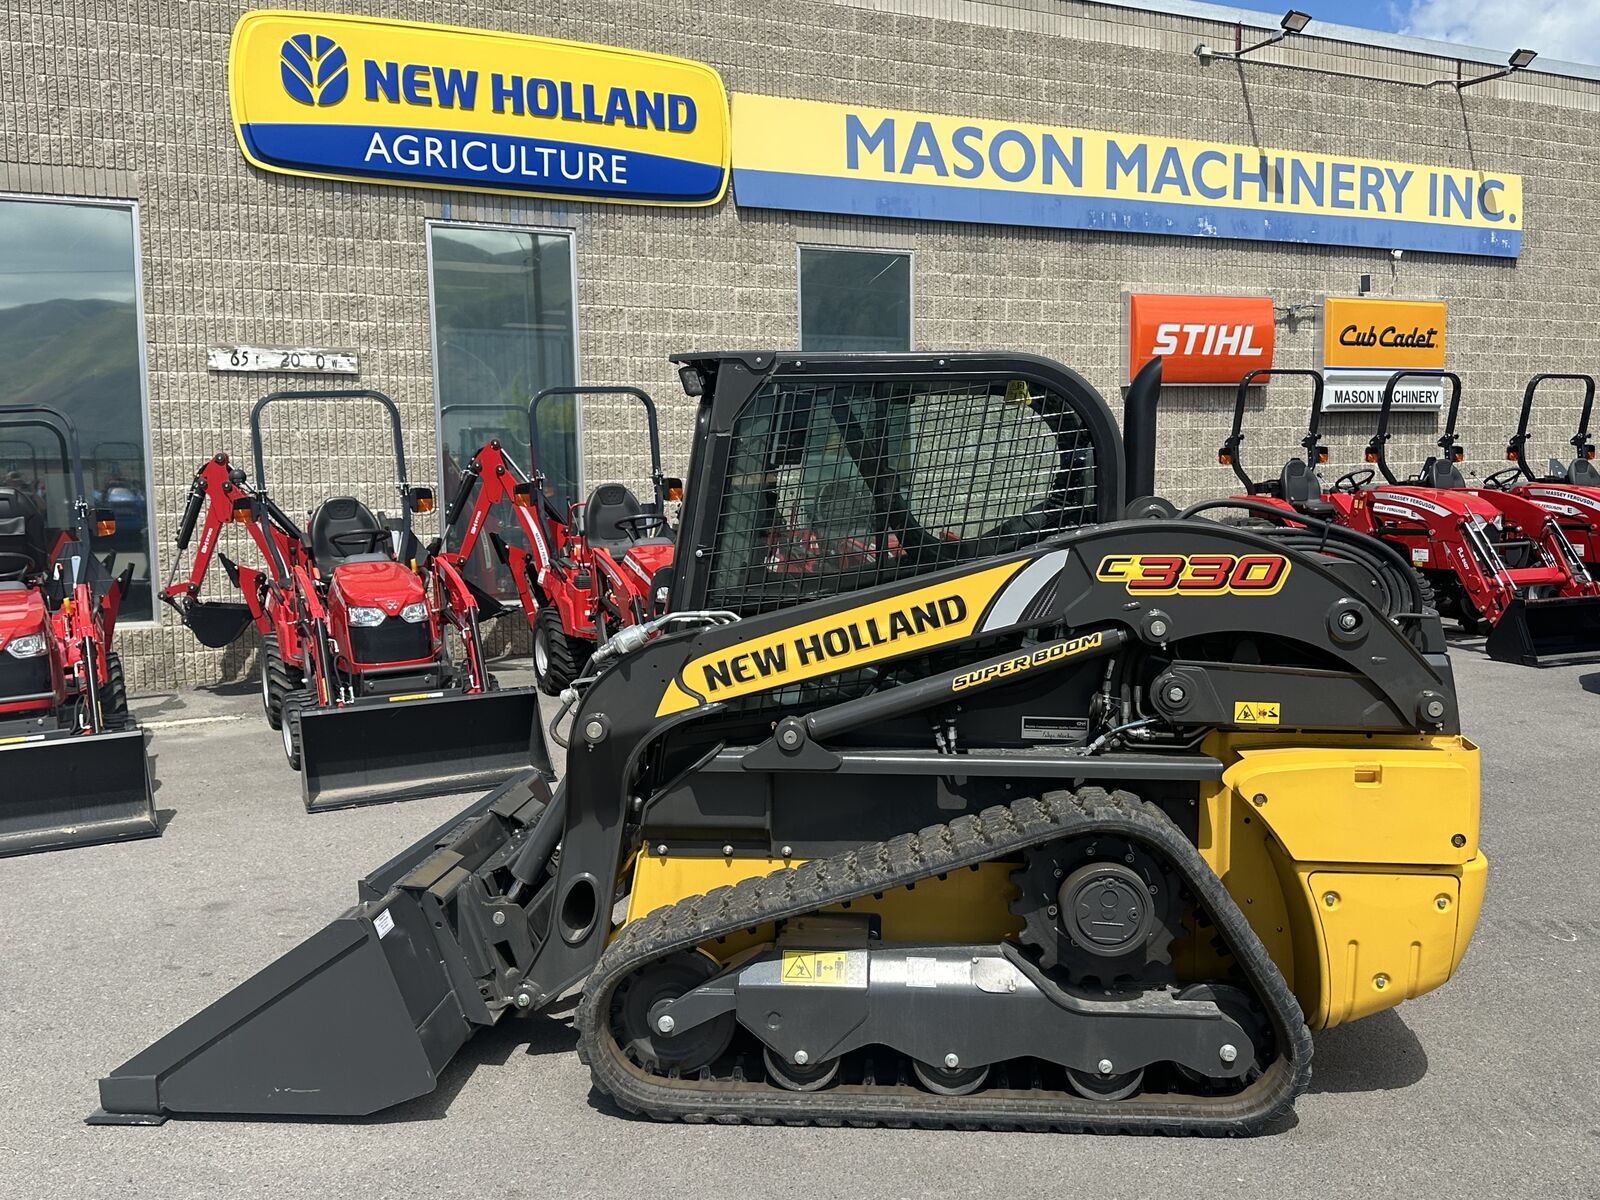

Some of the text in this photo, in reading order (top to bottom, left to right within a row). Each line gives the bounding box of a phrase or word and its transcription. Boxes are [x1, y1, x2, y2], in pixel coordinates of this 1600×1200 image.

[364, 60, 698, 133] NEW HOLLAND
[364, 132, 628, 185] AGRICULTURE
[844, 114, 1518, 223] MASON MACHINERY INC.
[1151, 323, 1263, 356] STIHL
[1339, 324, 1438, 348] Cub Cadet
[1334, 390, 1439, 404] MASON MCHINERY
[1389, 494, 1436, 510] MASSEY FERGUSON
[1545, 490, 1595, 506] MASSEY FERGUSON
[1097, 554, 1291, 596] C330
[702, 595, 968, 692] NEW HOLLAND
[952, 631, 1103, 691] SUPER BOOM
